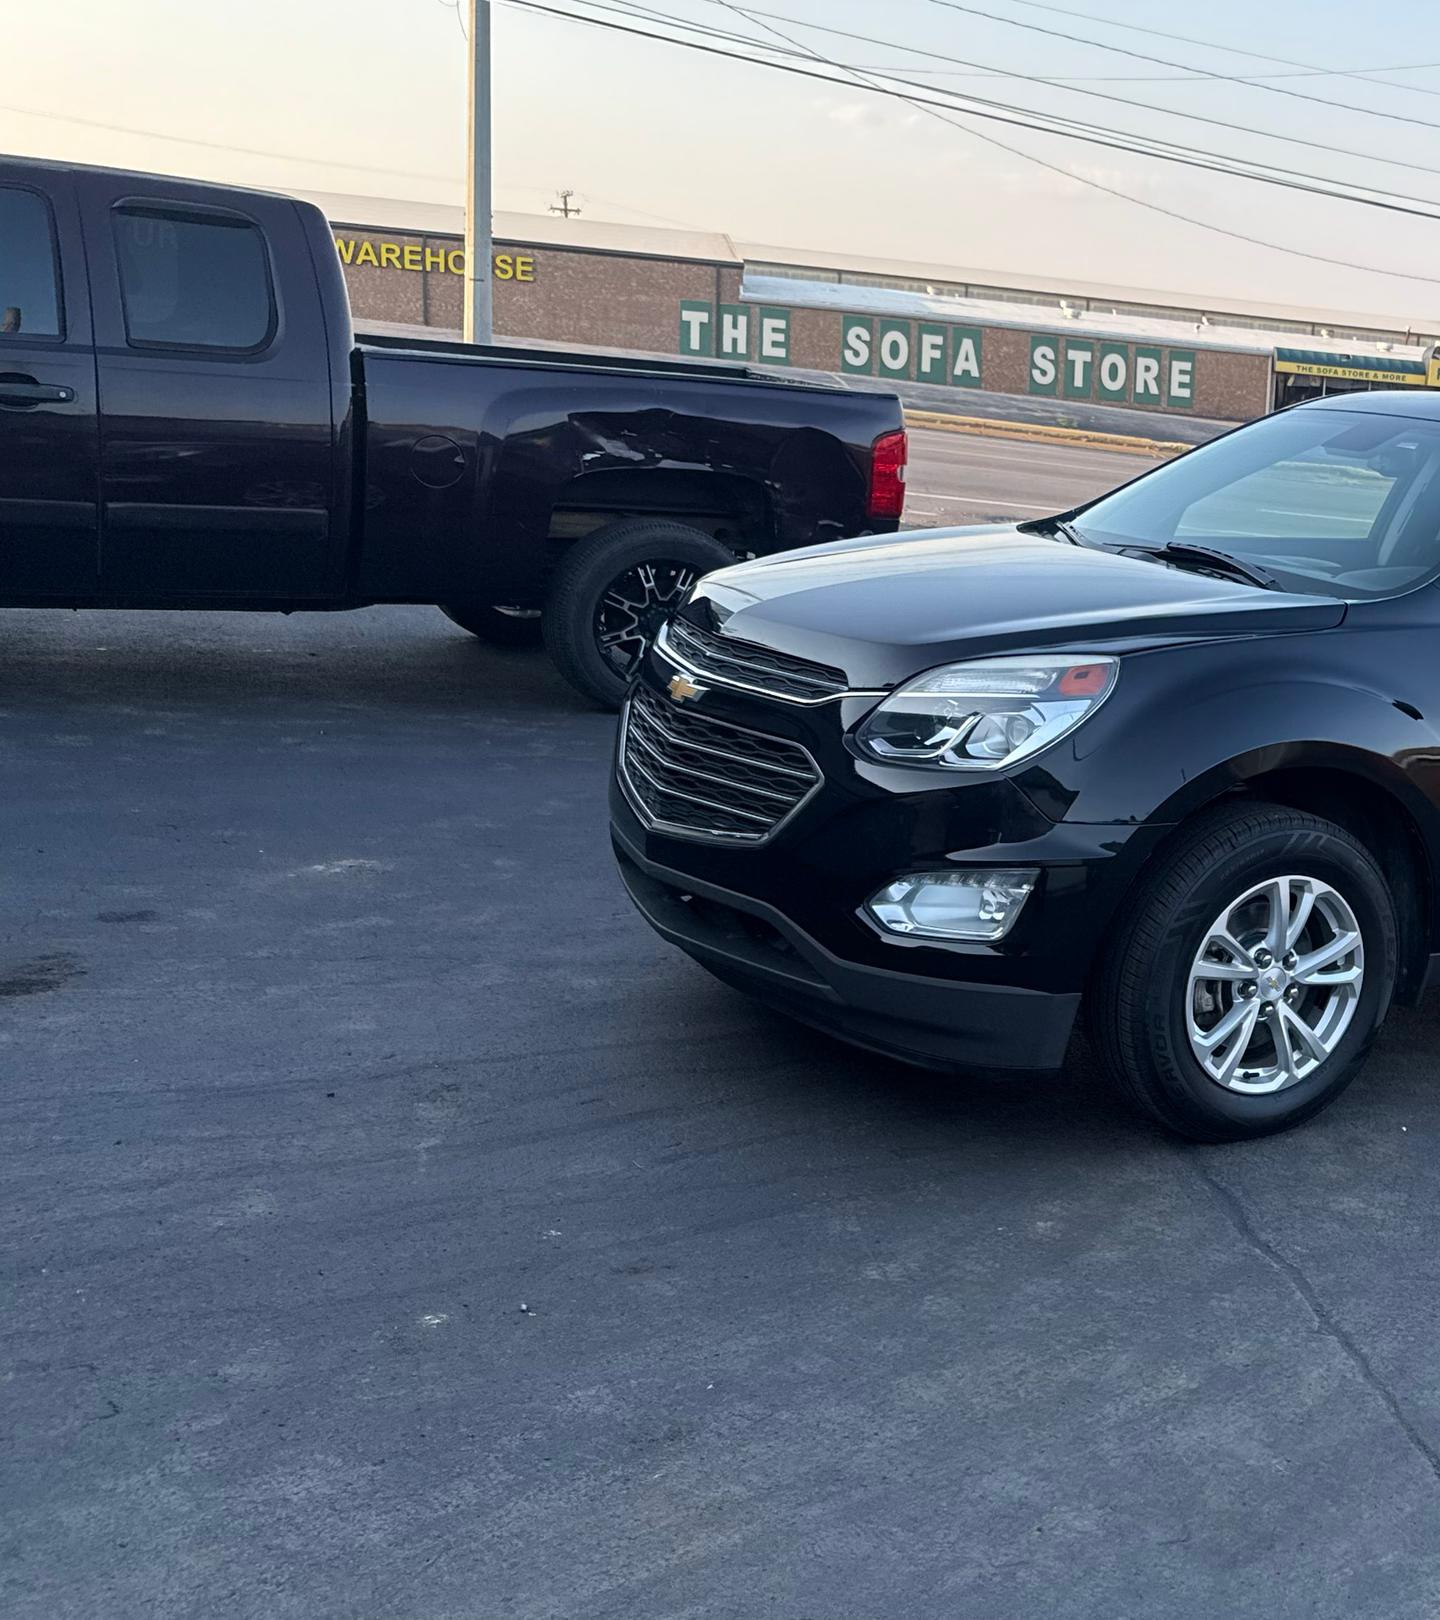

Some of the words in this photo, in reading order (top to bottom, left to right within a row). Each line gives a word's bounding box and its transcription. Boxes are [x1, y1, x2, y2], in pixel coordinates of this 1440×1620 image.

[335, 238, 535, 282] WAREHOSE
[681, 310, 787, 358] THE
[843, 326, 980, 378] SOFA
[1031, 346, 1192, 398] STORE
[1296, 365, 1313, 373] THE
[1316, 367, 1338, 376] SOFA
[1341, 369, 1370, 379] STORE
[1382, 373, 1407, 382] MORE
